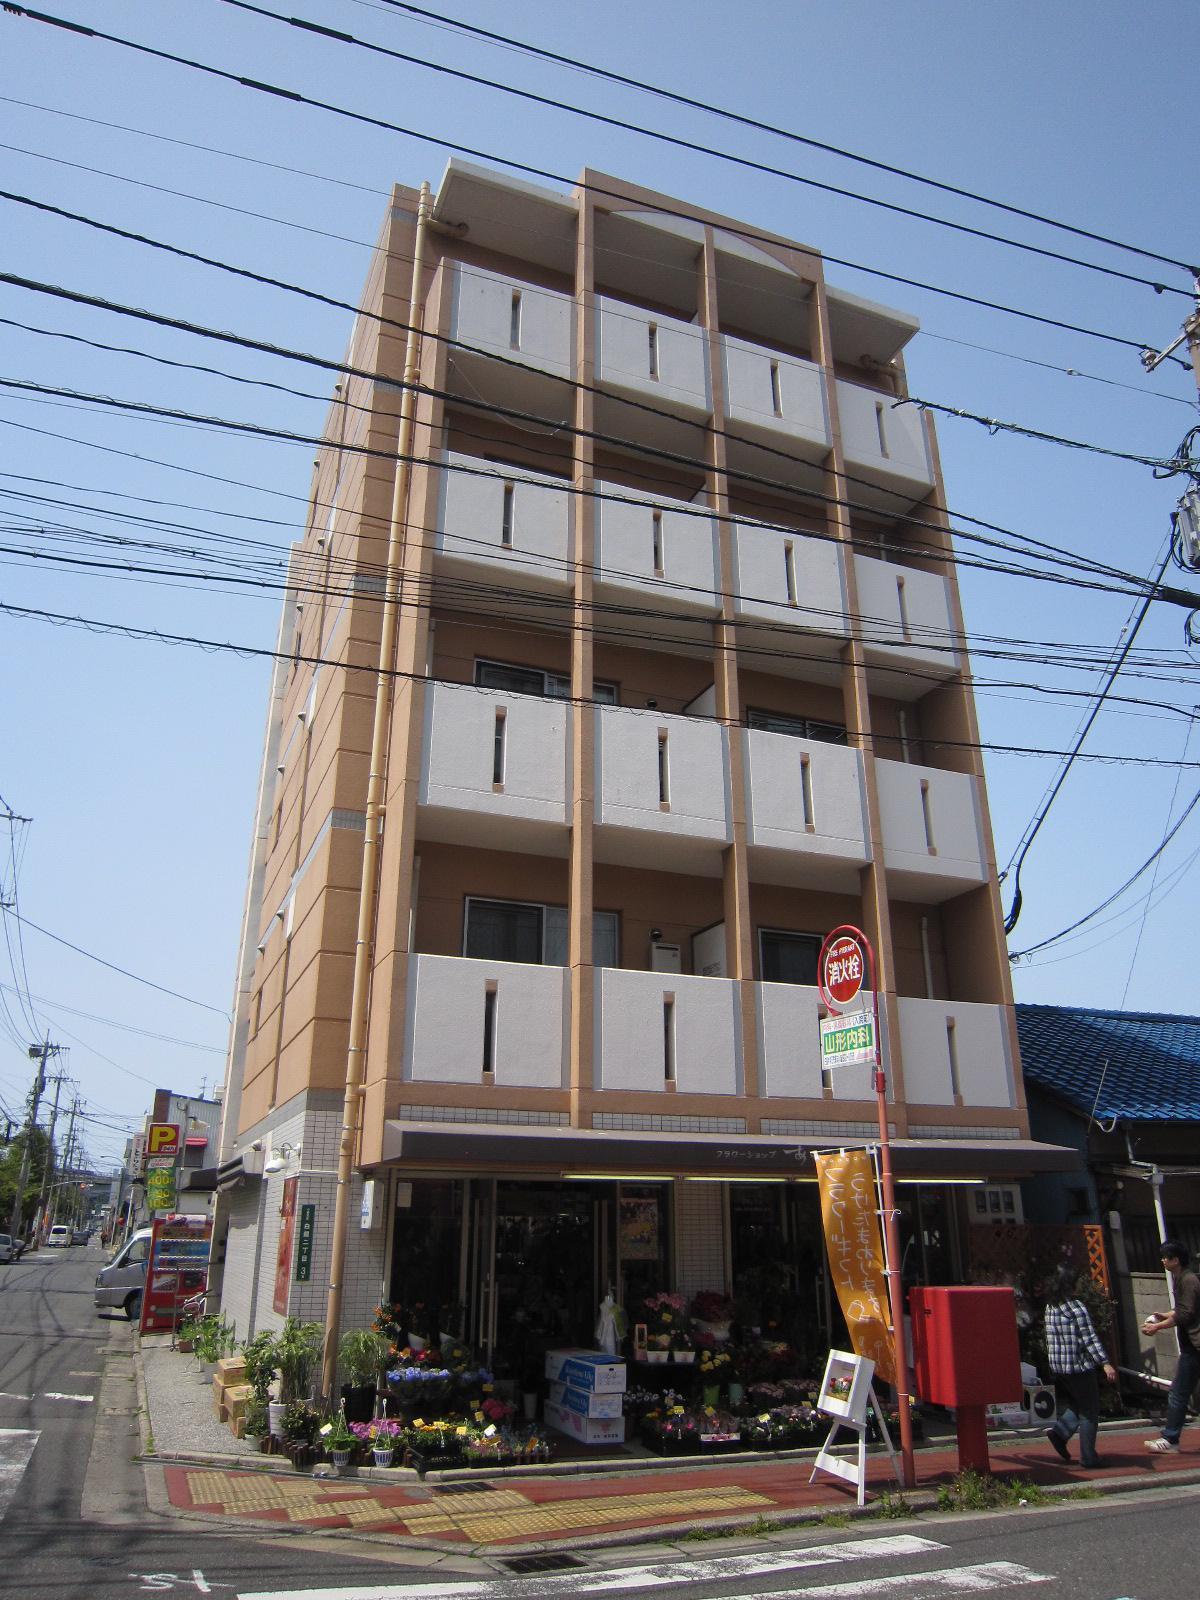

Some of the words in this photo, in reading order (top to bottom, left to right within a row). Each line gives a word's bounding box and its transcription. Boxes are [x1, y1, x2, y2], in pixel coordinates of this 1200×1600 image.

[828, 954, 861, 987] 消火栓
[824, 1024, 870, 1054] 山形内科
[151, 1126, 176, 1152] P
[717, 1149, 776, 1160] フラワーショップ
